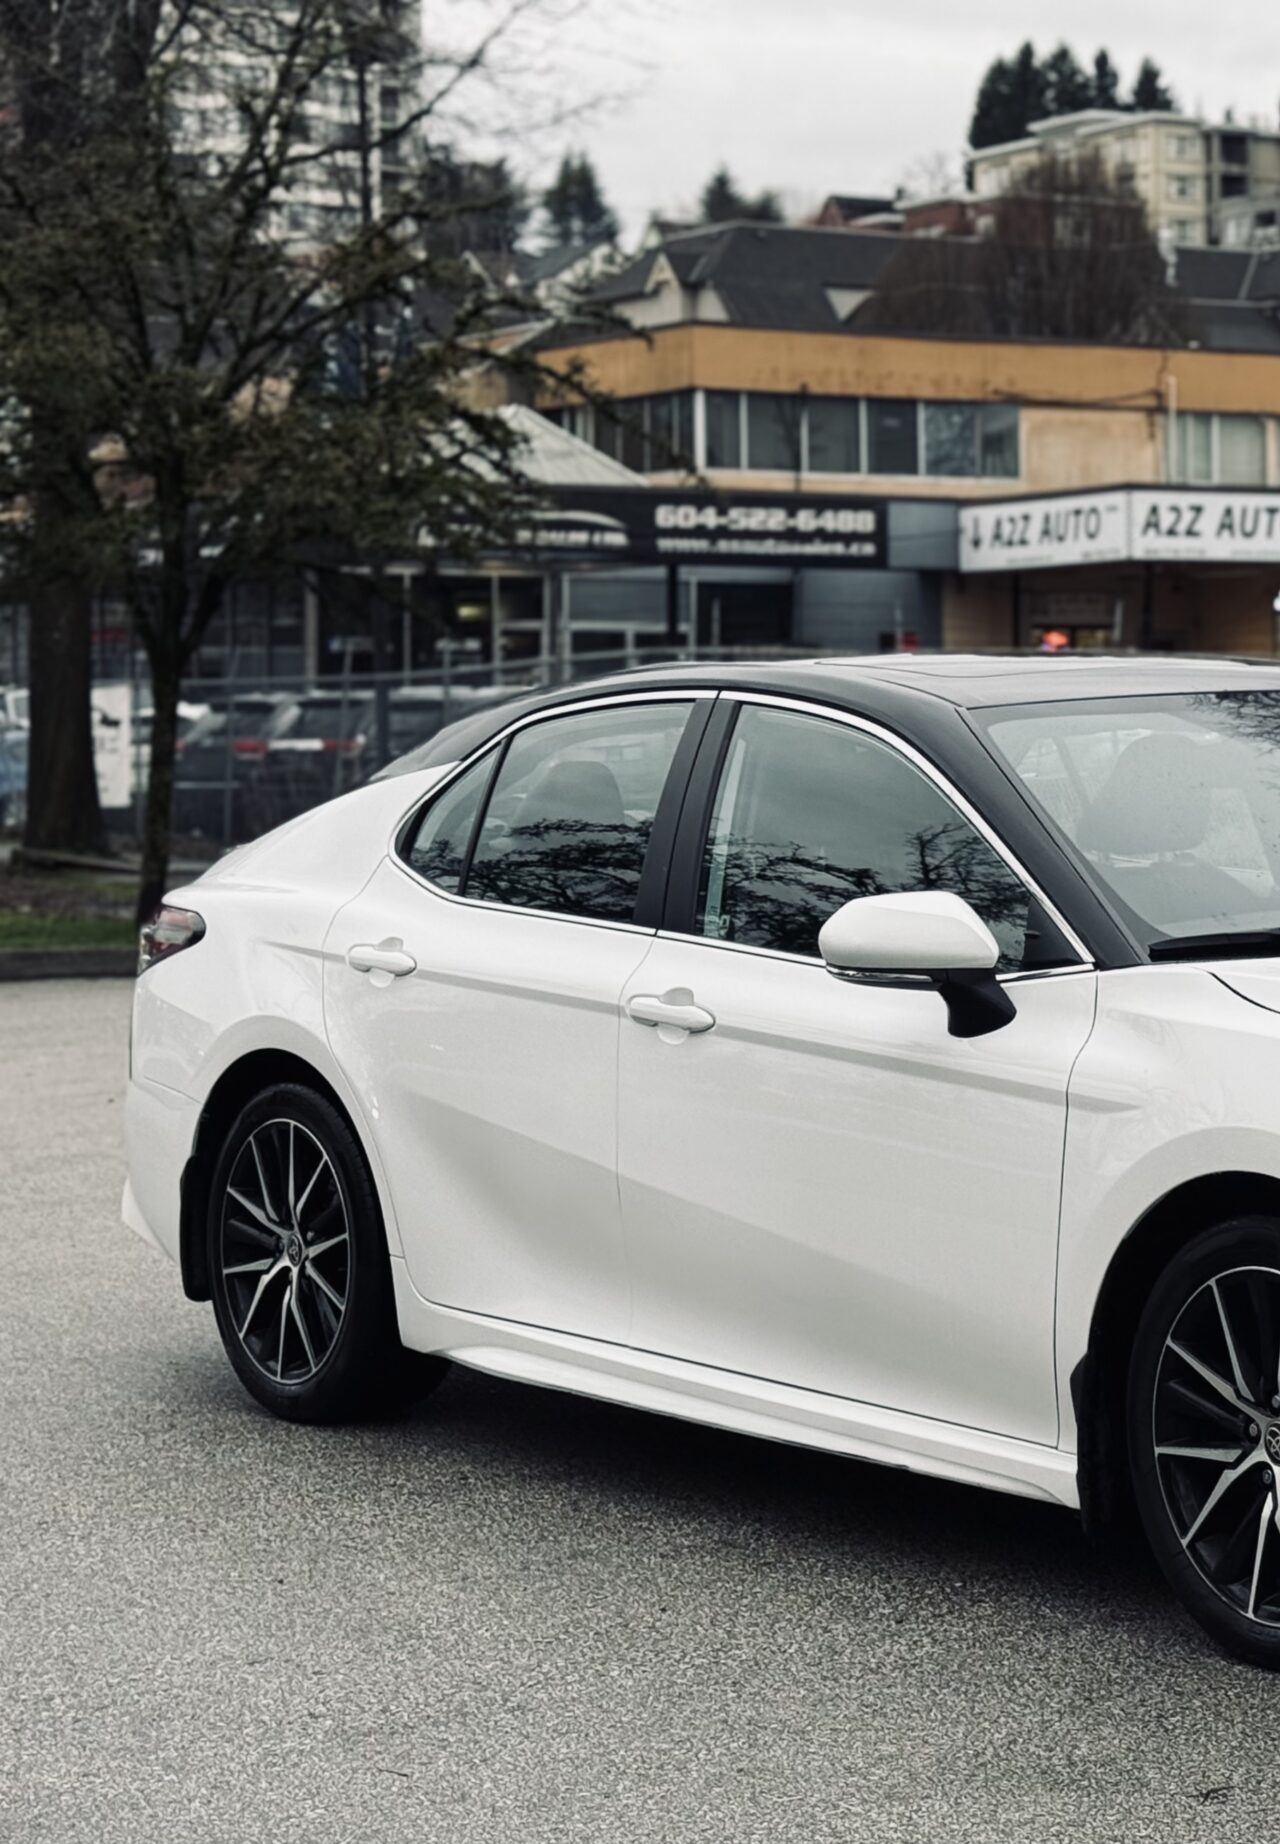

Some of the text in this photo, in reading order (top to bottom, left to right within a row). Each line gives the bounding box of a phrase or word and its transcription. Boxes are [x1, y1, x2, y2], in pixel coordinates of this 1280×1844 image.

[990, 507, 1101, 548] A2Z AUTO
[1142, 505, 1205, 537] A2Z
